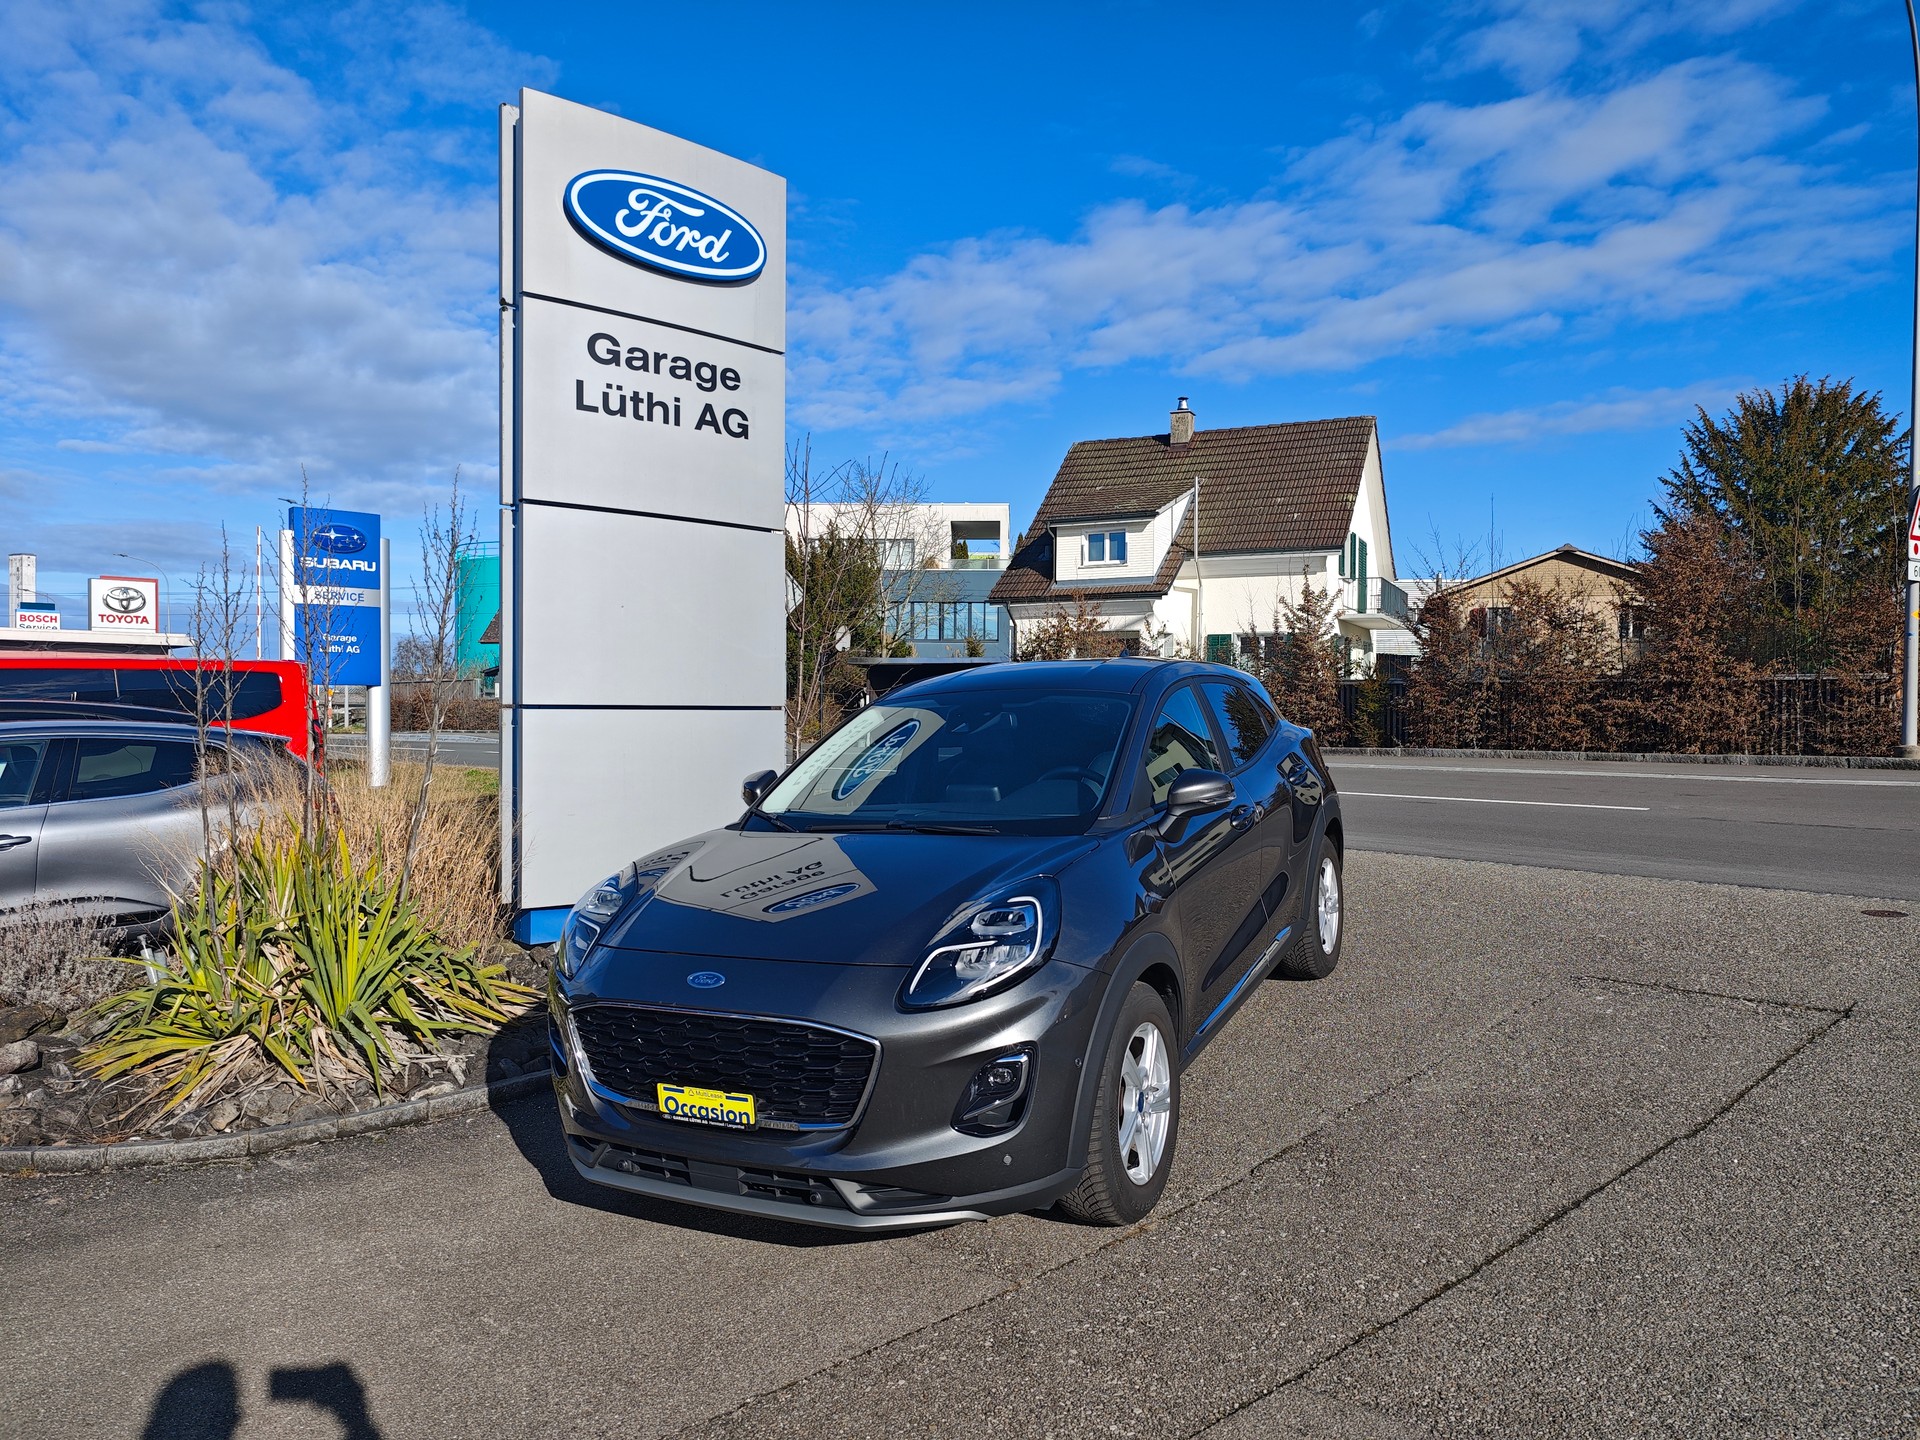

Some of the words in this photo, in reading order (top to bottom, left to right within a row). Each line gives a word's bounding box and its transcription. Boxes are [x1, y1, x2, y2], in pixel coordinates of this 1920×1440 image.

[615, 188, 732, 263] Ford
[587, 332, 742, 393] Garage
[575, 379, 682, 427] Lüthi
[694, 403, 750, 440] AG
[300, 556, 376, 572] SUBARU
[1913, 565, 1920, 578] 6
[315, 590, 365, 602] SERVICE
[19, 614, 58, 623] BOSCH
[98, 614, 150, 625] TOYOTA
[322, 633, 357, 643] Garage
[346, 645, 360, 653] AG
[664, 1095, 751, 1126] Occasion
